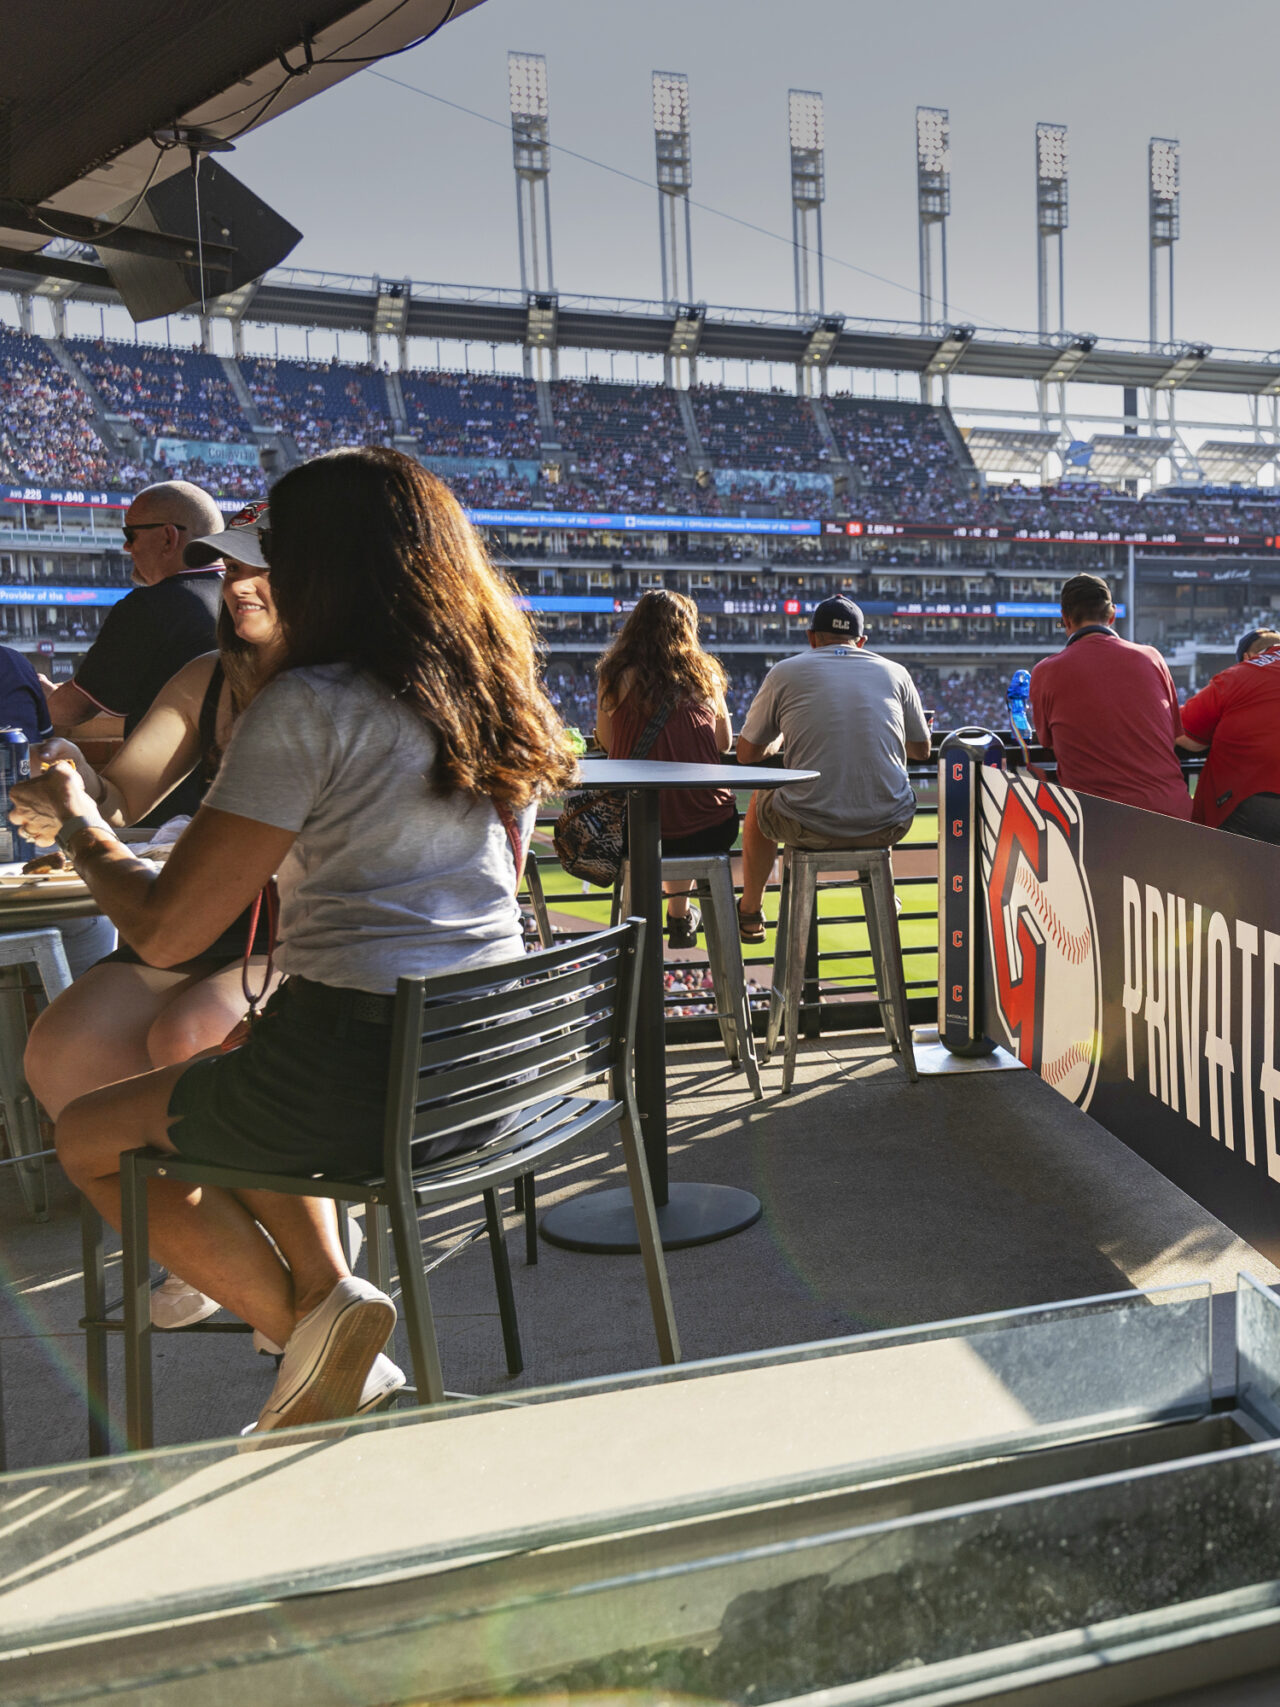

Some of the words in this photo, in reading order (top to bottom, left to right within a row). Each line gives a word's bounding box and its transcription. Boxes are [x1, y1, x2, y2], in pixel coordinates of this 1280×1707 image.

[0, 591, 35, 600] Provider
[37, 591, 47, 600] of
[49, 591, 64, 601] the
[832, 618, 850, 630] CLE
[953, 763, 963, 781] C
[953, 819, 963, 837] C
[953, 875, 963, 893] C
[953, 930, 963, 948] C
[953, 985, 963, 1002] C
